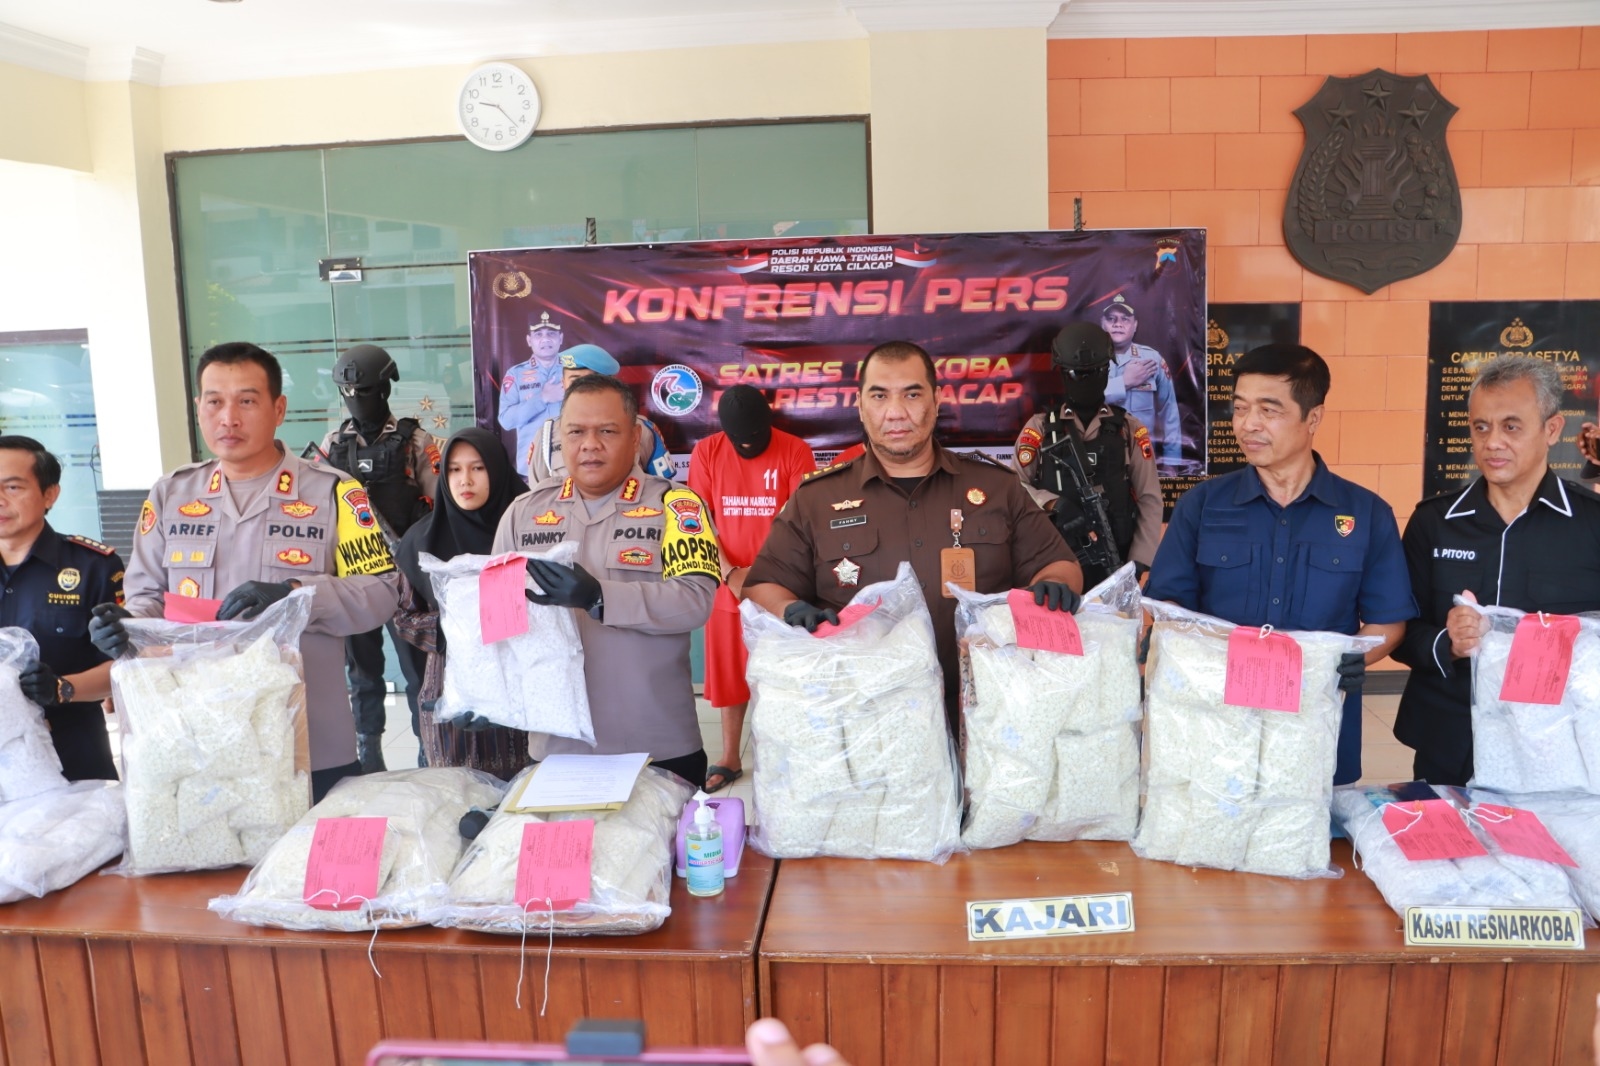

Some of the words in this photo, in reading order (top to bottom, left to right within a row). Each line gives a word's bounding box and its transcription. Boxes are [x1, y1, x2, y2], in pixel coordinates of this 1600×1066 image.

[479, 77, 486, 87] 11
[492, 72, 502, 83] 12
[469, 89, 479, 99] 10
[517, 85, 525, 95] 2
[466, 103, 474, 113] 9
[522, 100, 530, 110] 3
[471, 117, 479, 127] 8
[519, 115, 526, 124] 4
[482, 128, 489, 138] 7
[495, 130, 503, 140] 6
[509, 126, 517, 136] 5
[1331, 223, 1425, 242] POLISI
[771, 248, 799, 256] POLISI
[802, 247, 844, 255] REPUBLIK
[847, 245, 893, 253] INDONESIA
[770, 255, 813, 265] DAERAH
[816, 255, 846, 263] JAWA
[851, 253, 893, 262] TENGAH
[770, 264, 809, 273] RESOR
[813, 263, 842, 272] KOTA
[847, 261, 893, 271] CILACAP
[602, 279, 903, 324] KONFRENSI
[924, 276, 1070, 314] PERS
[1451, 351, 1498, 364] CATUR
[718, 361, 843, 386] SATRES
[763, 468, 778, 490] 11
[721, 495, 749, 507] TAHANAN
[750, 496, 776, 507] NARKOBA
[169, 523, 216, 537] ARIEF
[268, 524, 324, 540] POLRI
[521, 531, 567, 546] FANNKY
[613, 527, 662, 542] POLRI
[1441, 548, 1476, 561] PITOYO
[677, 560, 700, 573] CANDI
[48, 592, 80, 600] CUSTOMS
[974, 900, 1128, 934] KAJARI
[1412, 912, 1462, 939] KASAT
[1468, 914, 1575, 942] RESNARKOBA
